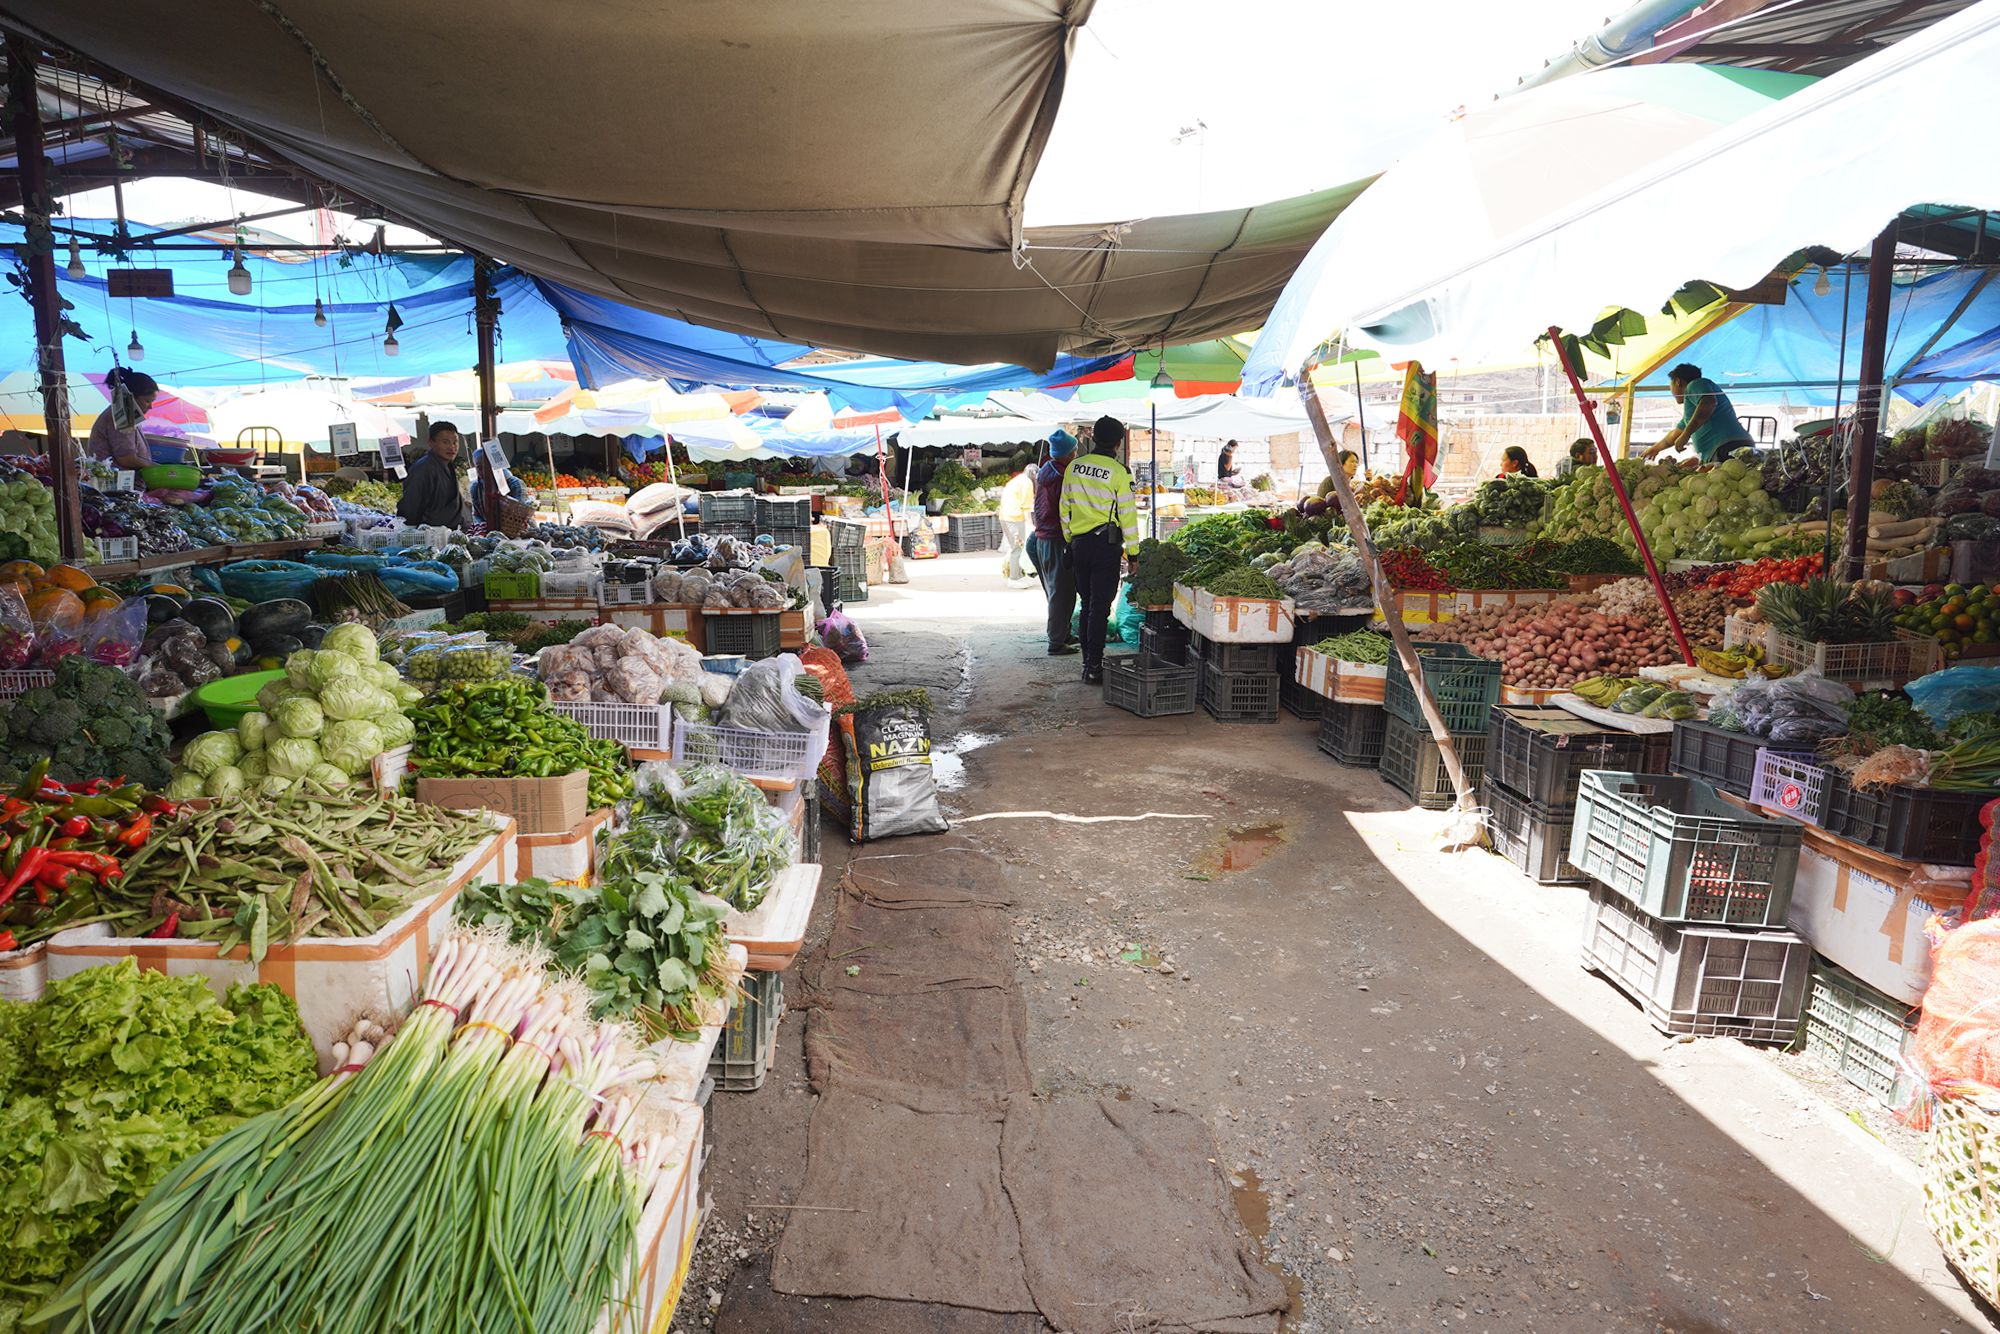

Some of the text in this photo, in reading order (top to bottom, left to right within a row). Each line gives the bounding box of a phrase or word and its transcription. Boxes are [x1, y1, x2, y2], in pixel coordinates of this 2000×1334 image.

[1073, 464, 1110, 480] POLICE
[881, 723, 924, 735] CLASSIC
[883, 731, 924, 742] MAGNUM
